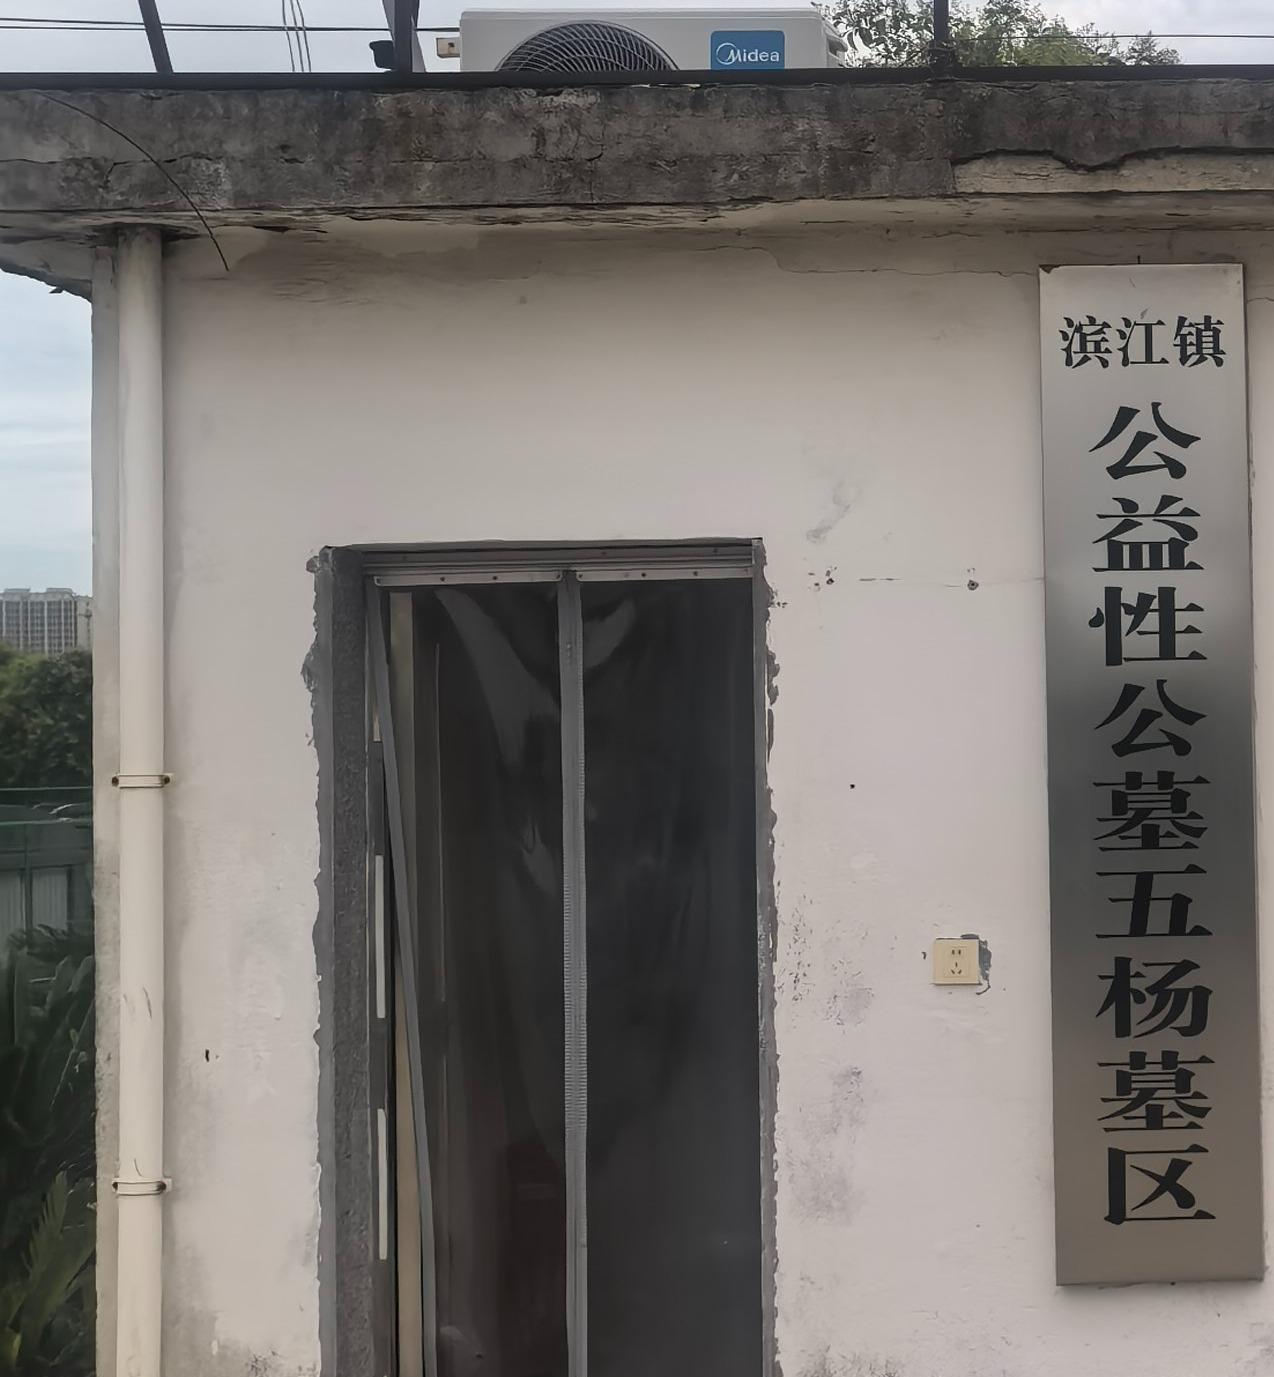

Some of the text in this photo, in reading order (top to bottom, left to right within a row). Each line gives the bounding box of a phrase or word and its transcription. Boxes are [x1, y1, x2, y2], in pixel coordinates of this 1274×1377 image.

[715, 42, 780, 64] Midea
[1058, 314, 1227, 369] 滨江镇
[1087, 401, 1217, 1226] 公益性公墓五杨墓区
